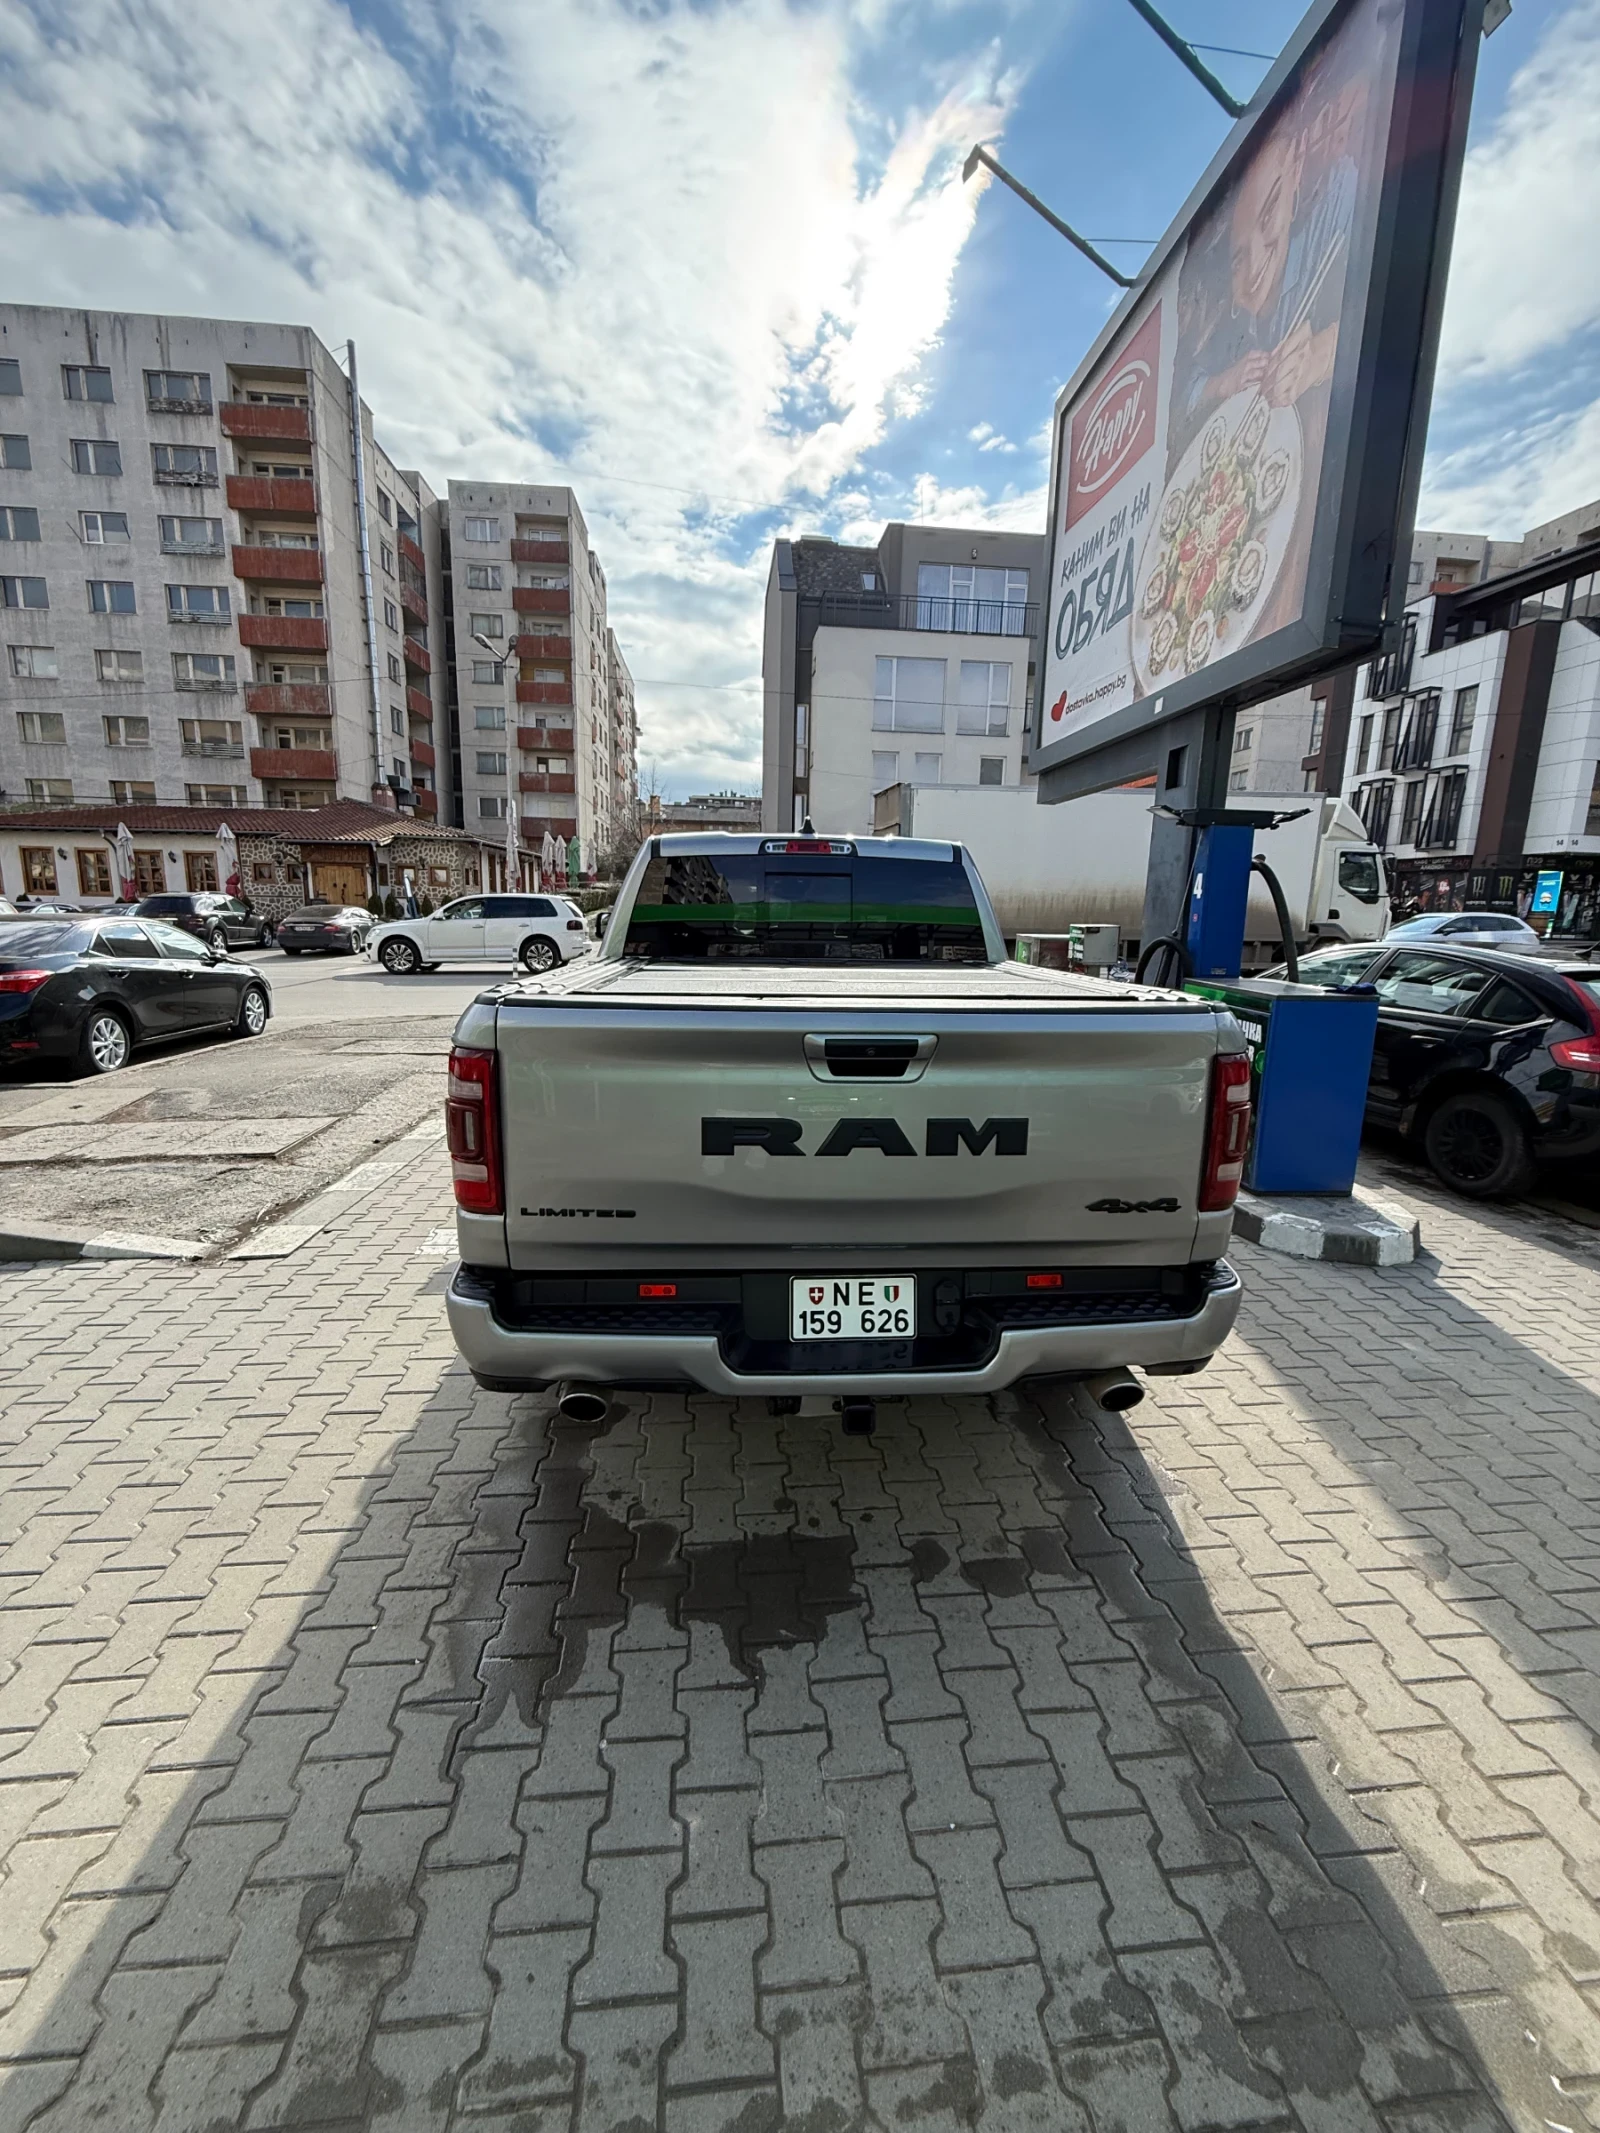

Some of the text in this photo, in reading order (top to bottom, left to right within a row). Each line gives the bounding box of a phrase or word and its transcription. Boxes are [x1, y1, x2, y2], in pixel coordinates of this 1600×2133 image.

[1082, 381, 1144, 481] Happy
[1061, 482, 1151, 587] КАНИМ ВИ НА
[1055, 536, 1135, 660] ОБЯД
[1065, 674, 1127, 716] dostavka.happy.bg
[1193, 873, 1203, 899] 4
[701, 1117, 1029, 1156] RAM
[520, 1207, 636, 1218] LIMITED
[799, 1309, 909, 1335] 159 626
